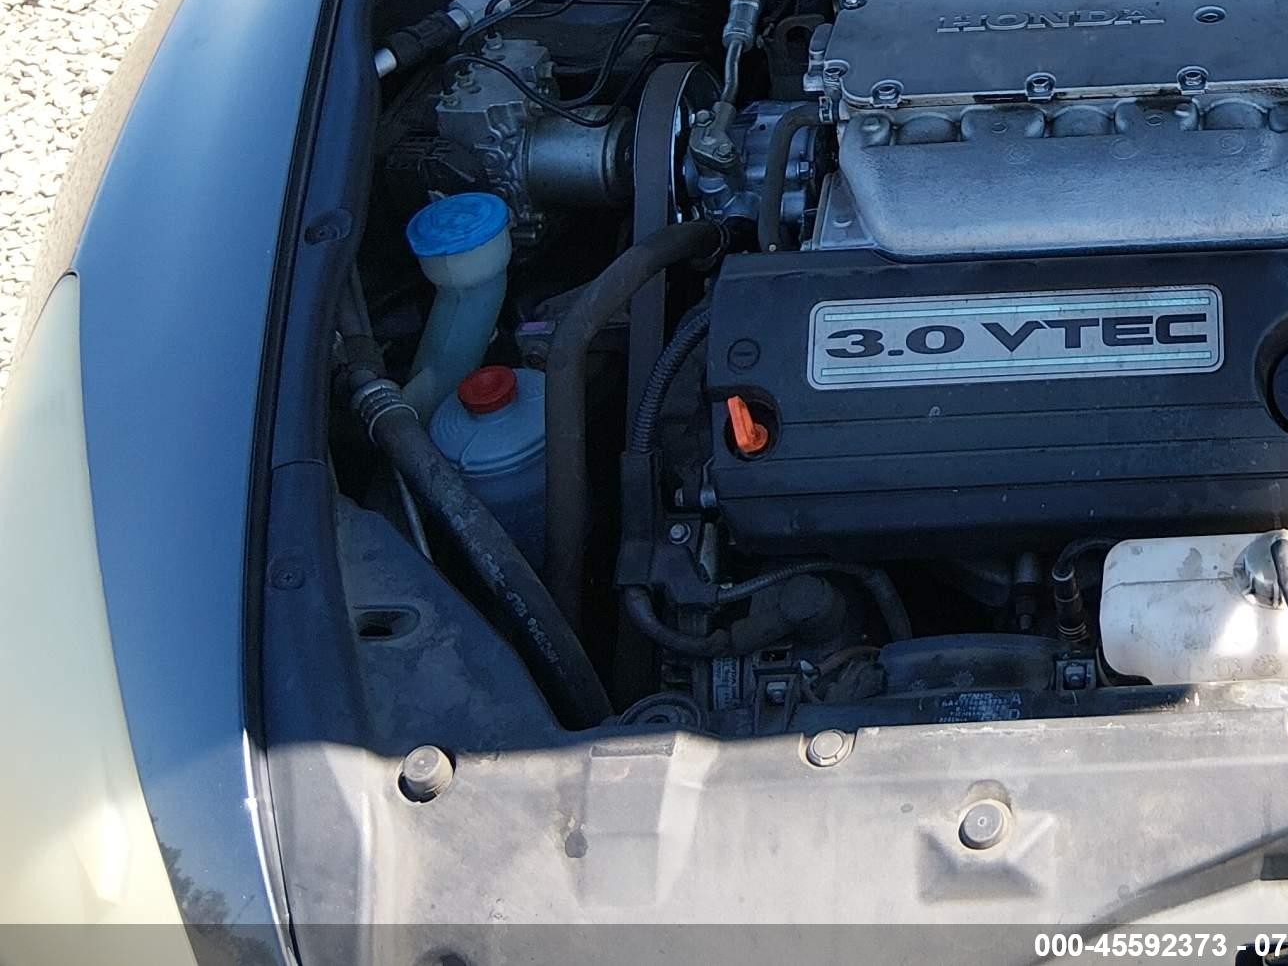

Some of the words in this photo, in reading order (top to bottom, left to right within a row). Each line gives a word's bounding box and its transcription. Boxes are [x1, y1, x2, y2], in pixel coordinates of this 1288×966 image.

[936, 9, 1165, 32] HONDA
[825, 325, 964, 359] 3.0
[981, 313, 1208, 352] VTEC
